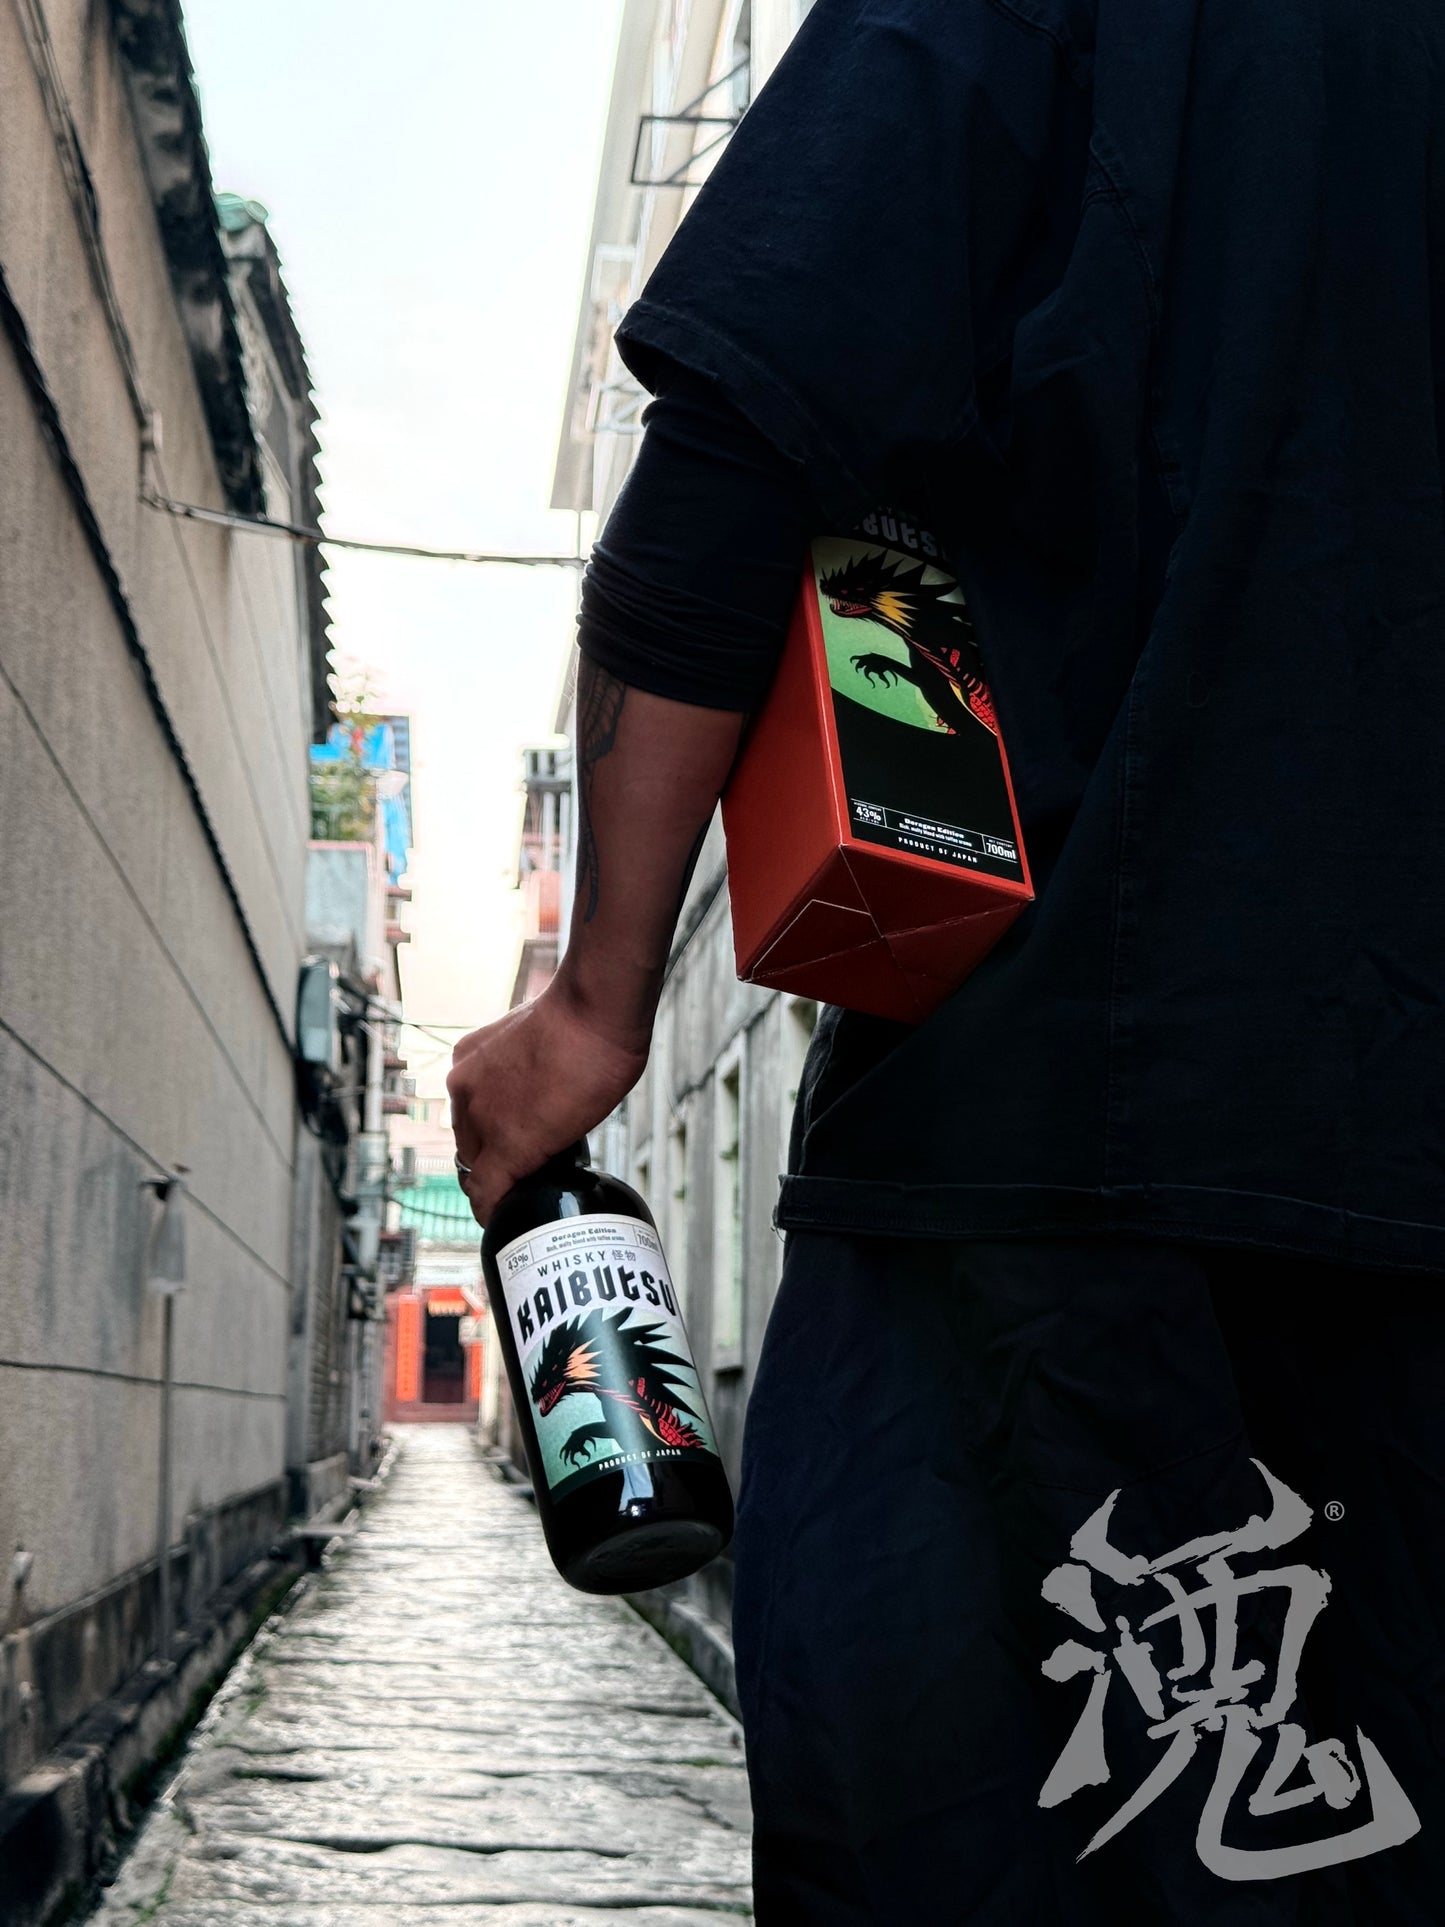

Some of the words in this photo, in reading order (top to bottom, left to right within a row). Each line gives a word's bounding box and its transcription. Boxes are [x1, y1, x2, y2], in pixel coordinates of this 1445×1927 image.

[856, 806, 882, 822] 43%
[937, 827, 964, 839] Edition
[898, 836, 934, 852] PRODUCT
[938, 847, 947, 855] OF
[952, 851, 978, 864] JAPAN
[986, 842, 1017, 860] 700ml
[552, 1231, 586, 1243] Doragon
[588, 1227, 617, 1235] Edition
[508, 1253, 529, 1271] 43%
[537, 1250, 606, 1277] WHISKY
[612, 1249, 636, 1262] 怪物
[598, 1452, 637, 1471] PRODUCT
[641, 1450, 651, 1459] OF
[656, 1448, 682, 1457] JAPAN
